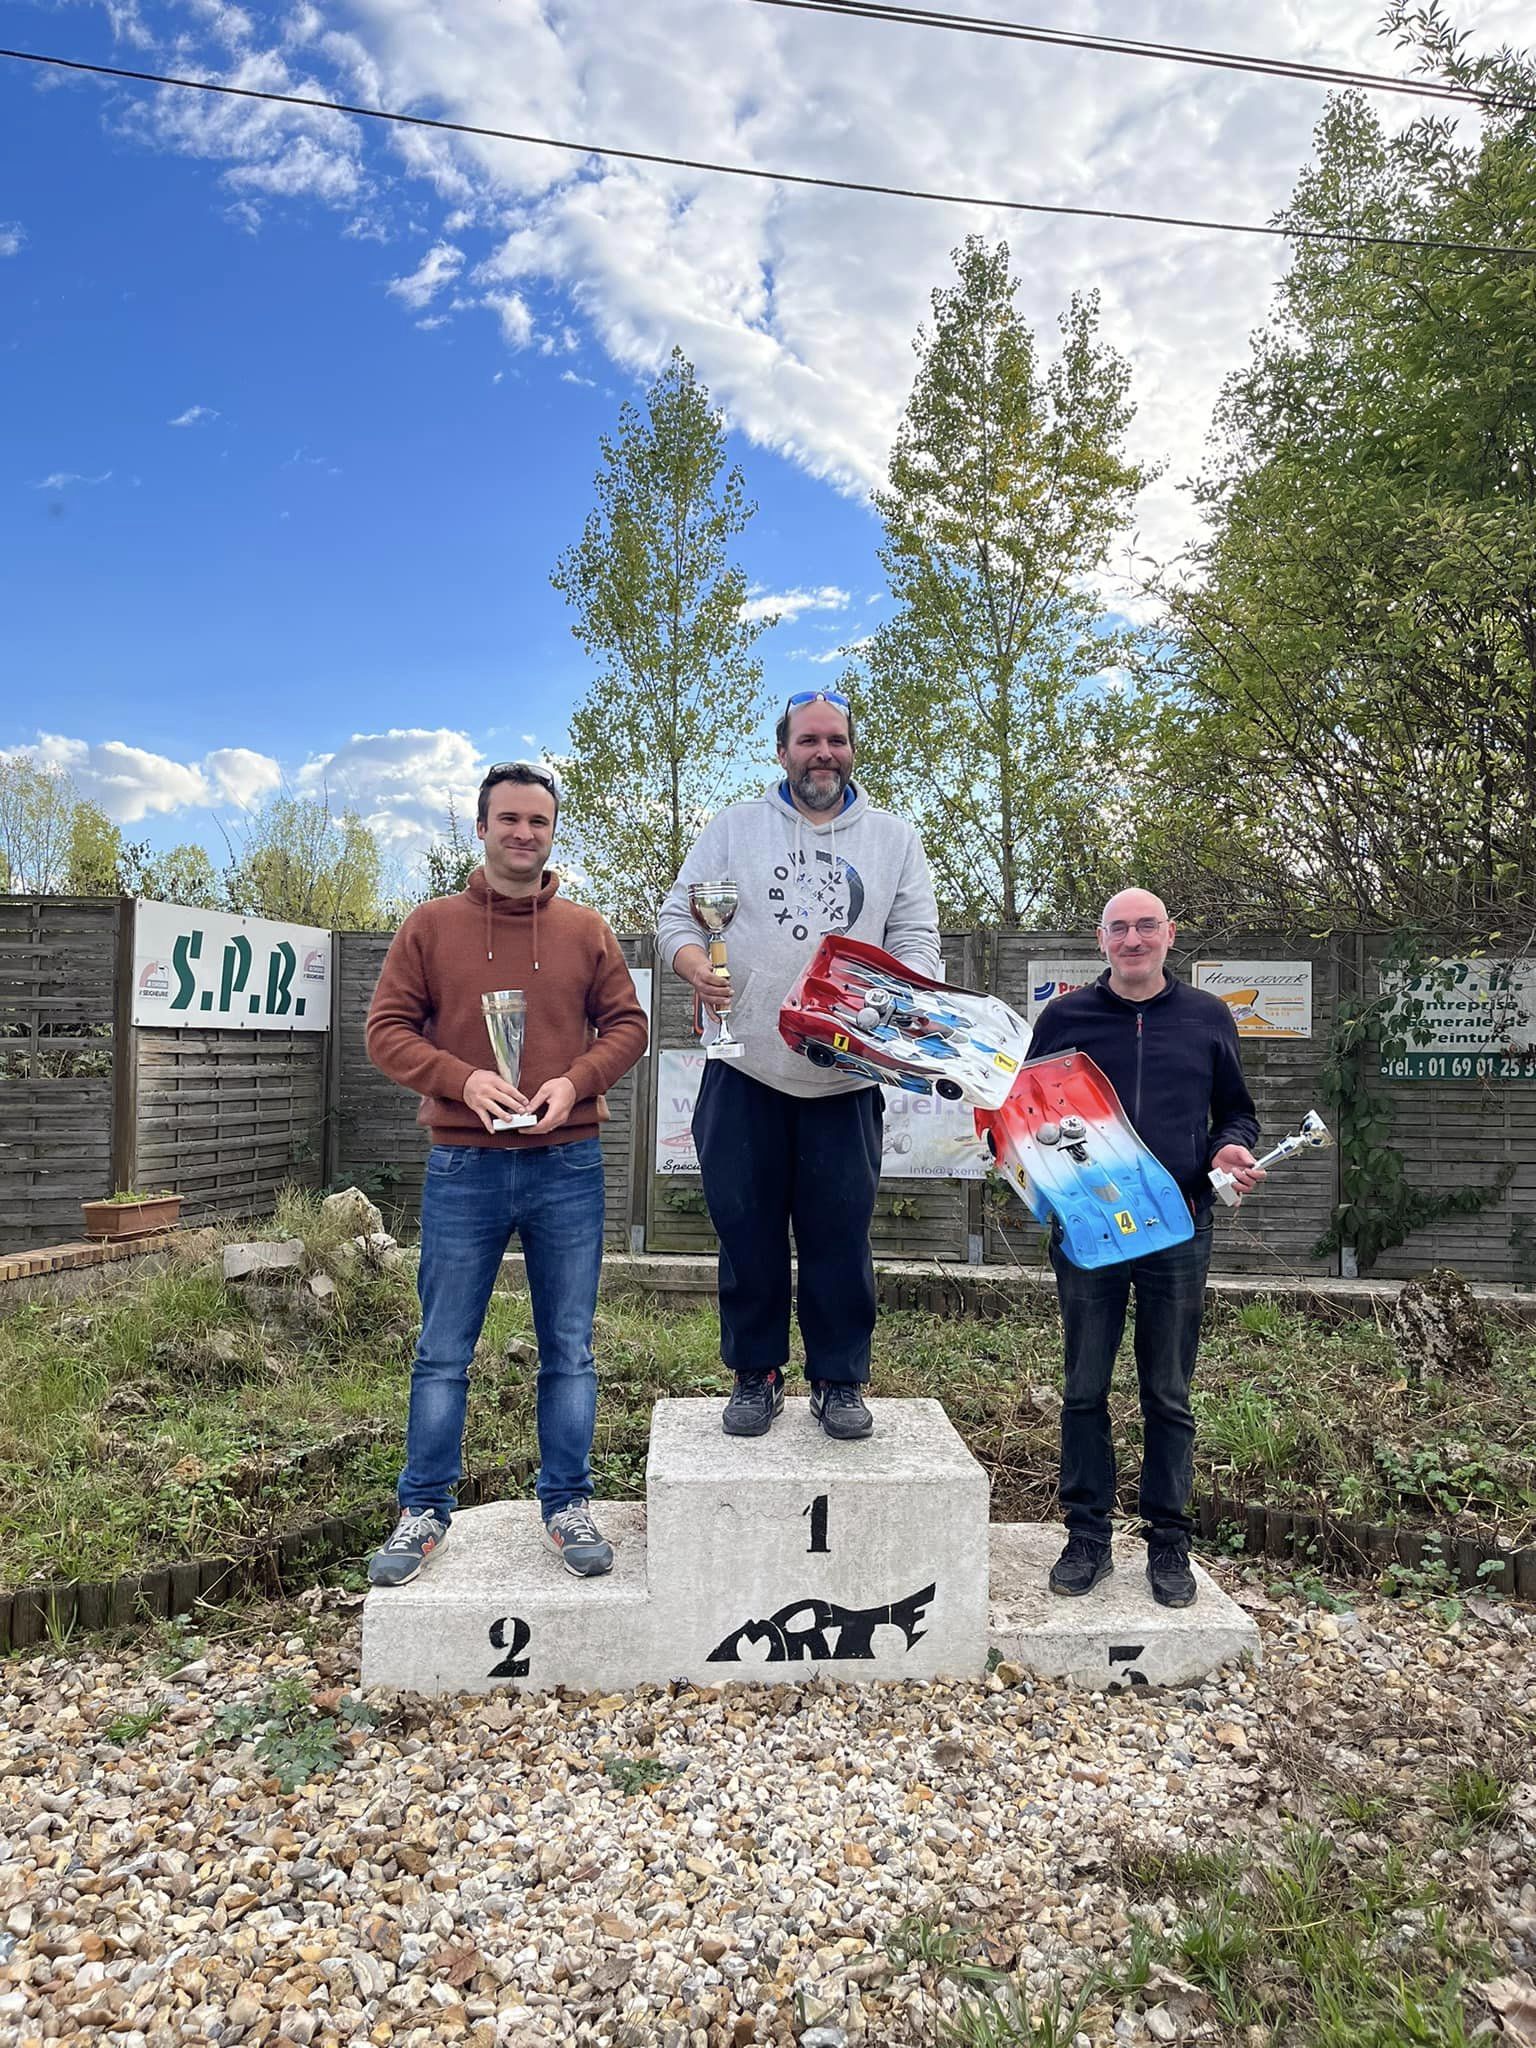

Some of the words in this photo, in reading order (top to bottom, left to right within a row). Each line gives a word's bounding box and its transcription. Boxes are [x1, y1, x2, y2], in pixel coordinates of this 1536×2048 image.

[169, 930, 306, 1016] S.P.B.
[1254, 973, 1309, 984] CENTER
[1416, 999, 1519, 1013] ntreprise
[1428, 1057, 1446, 1077] 01
[1452, 1057, 1472, 1077] 69
[1476, 1057, 1493, 1077] 01
[1500, 1058, 1520, 1077] 25
[1120, 1212, 1132, 1230] 4
[802, 1494, 832, 1552] 1
[487, 1616, 531, 1678] 2
